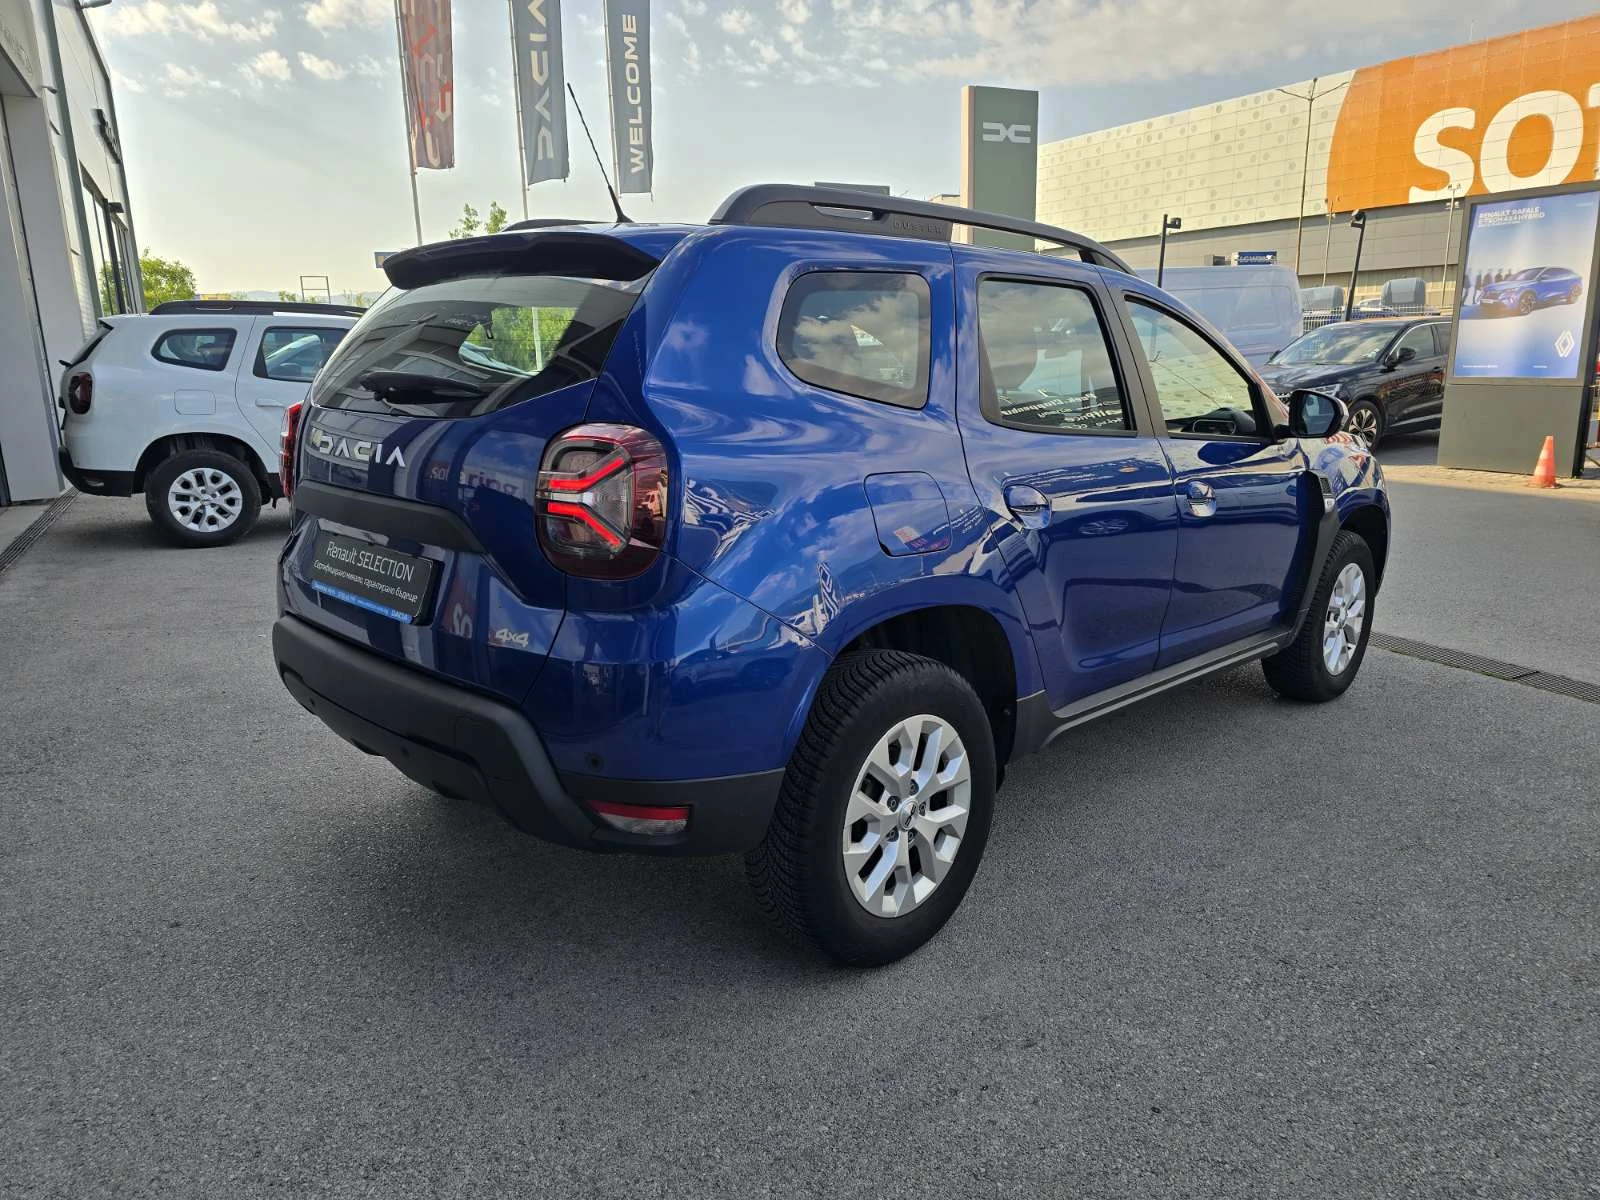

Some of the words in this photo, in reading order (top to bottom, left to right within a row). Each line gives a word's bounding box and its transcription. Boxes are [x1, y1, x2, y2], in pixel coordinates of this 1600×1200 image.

[623, 14, 644, 173] WELCOME
[318, 433, 406, 468] DACIA
[326, 541, 358, 565] Renault
[358, 553, 414, 583] SELECTION
[495, 627, 530, 649] 4x4
